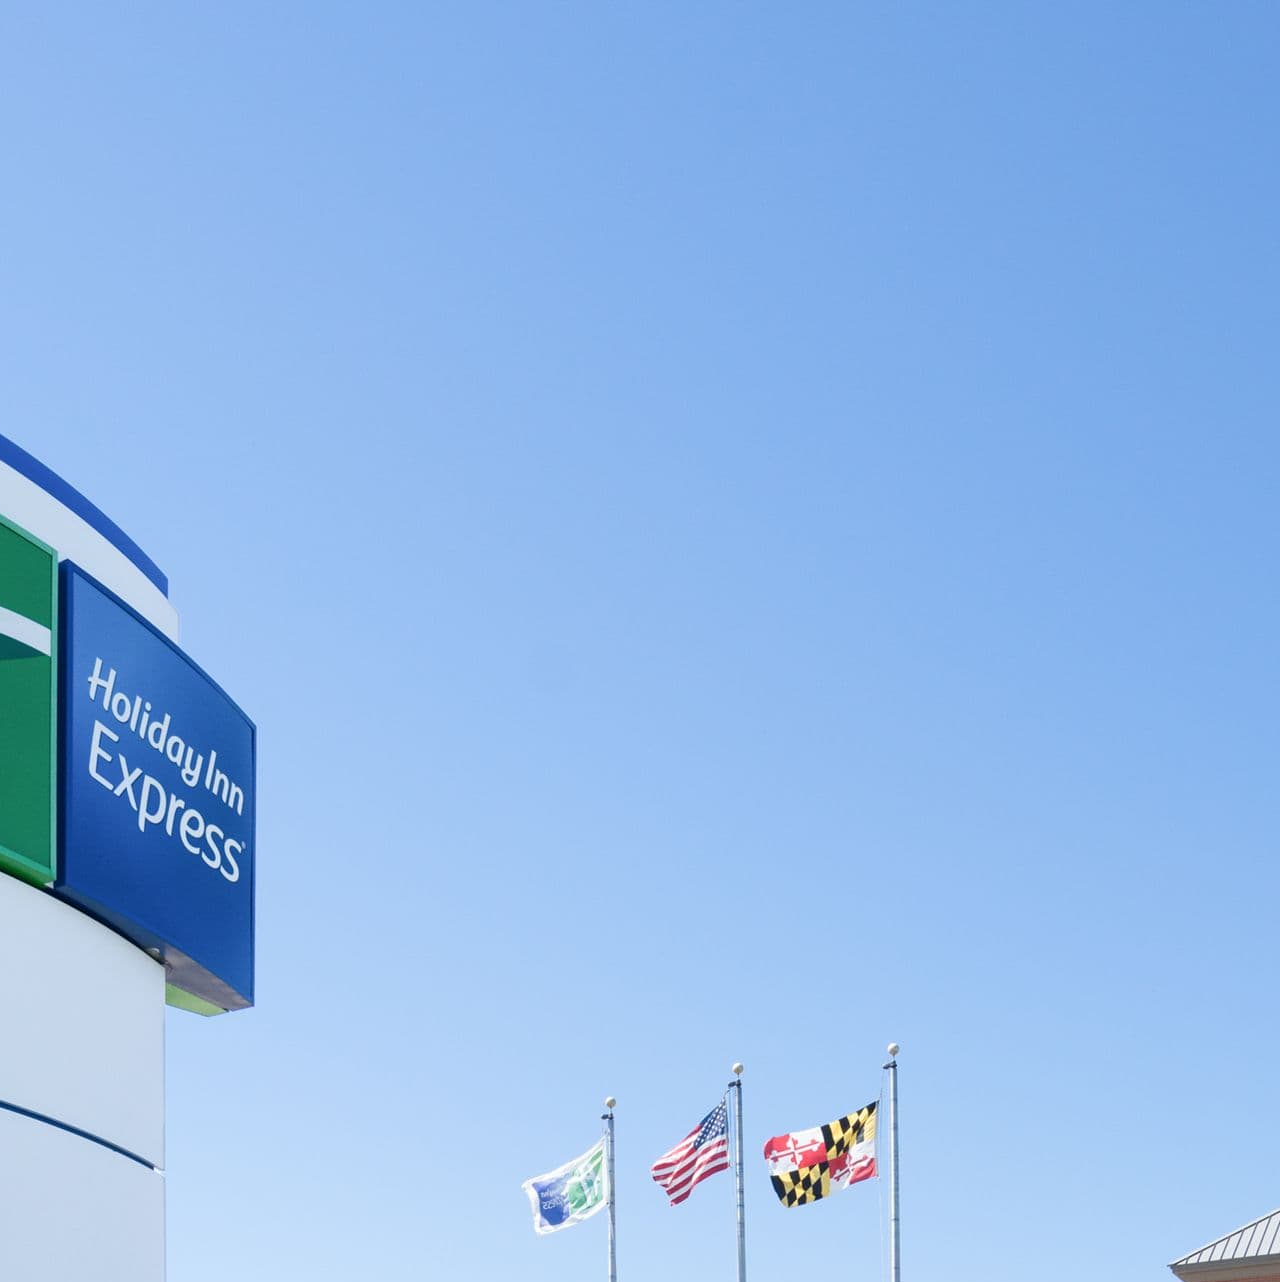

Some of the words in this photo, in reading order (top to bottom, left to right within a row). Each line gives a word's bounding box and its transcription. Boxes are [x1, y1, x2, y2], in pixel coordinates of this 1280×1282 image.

[87, 656, 204, 788] Holiday
[204, 750, 245, 817] Inn
[88, 719, 243, 883] Express
